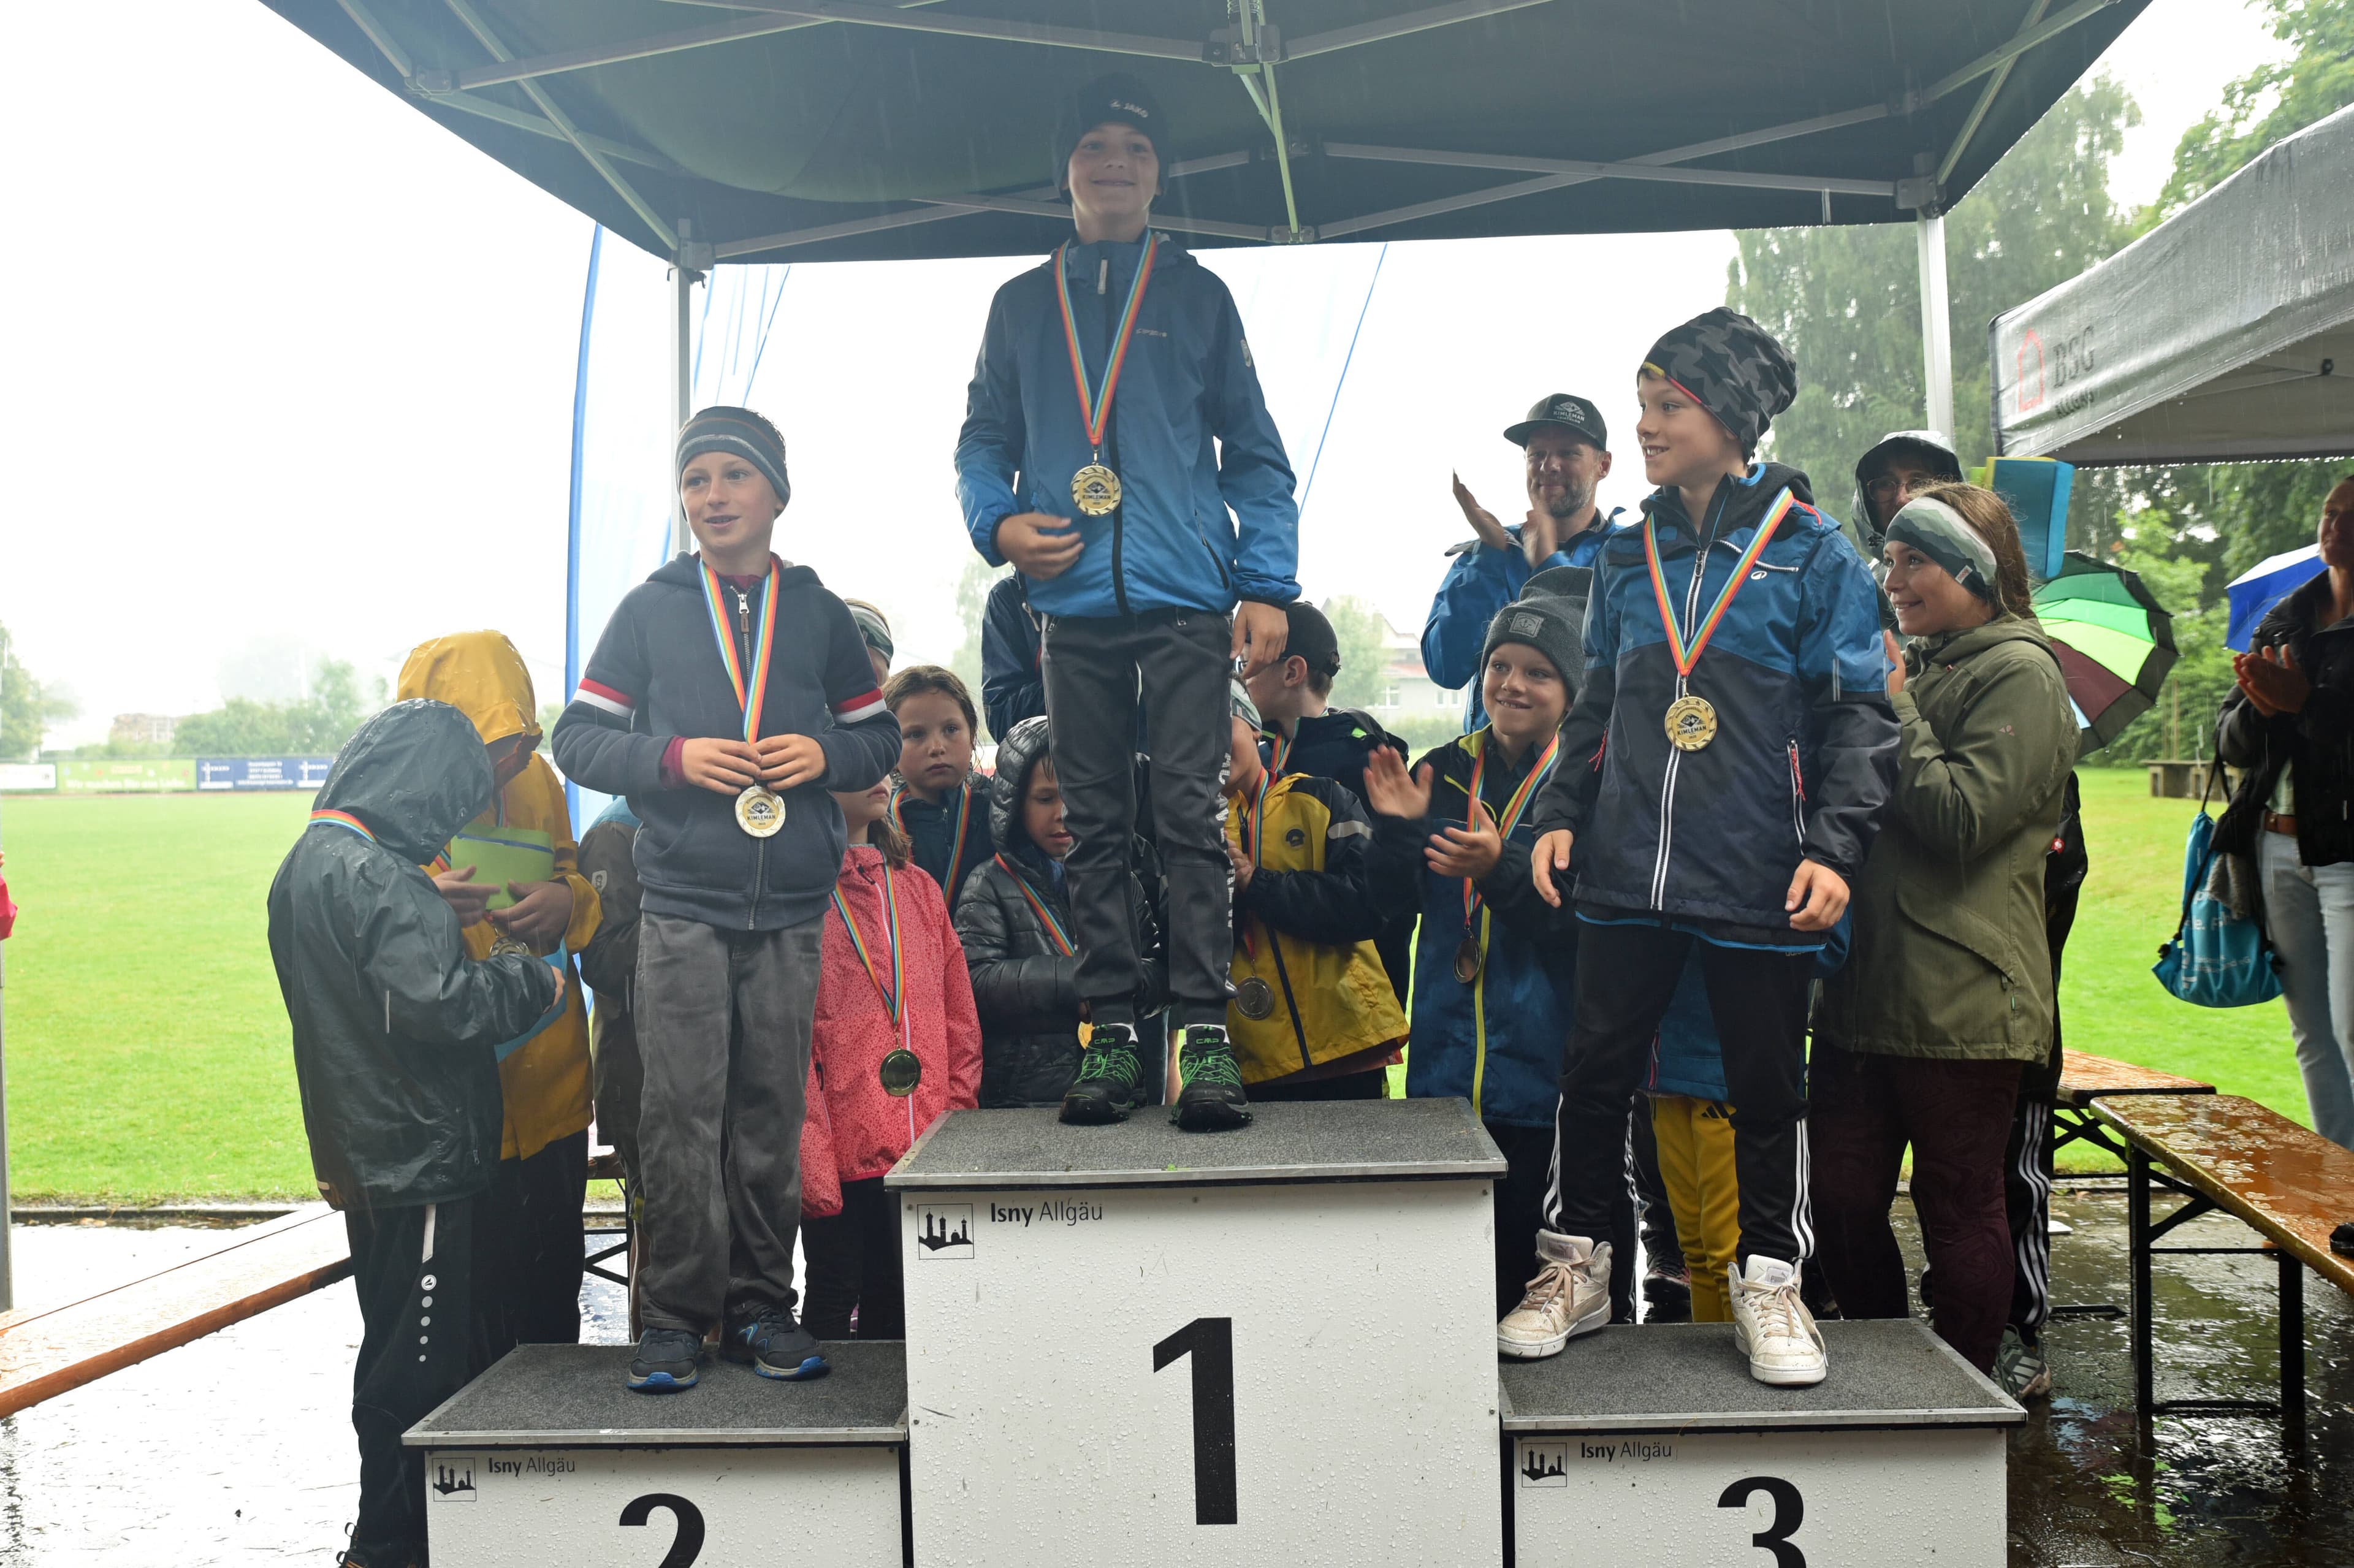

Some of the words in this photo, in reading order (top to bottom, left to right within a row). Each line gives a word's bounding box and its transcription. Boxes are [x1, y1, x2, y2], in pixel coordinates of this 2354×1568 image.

[2053, 325, 2095, 389] BSG
[1553, 411, 1585, 422] KIMLEMAN
[1677, 725, 1707, 736] KIMLEMAN
[990, 1203, 1033, 1227] Isny
[1038, 1199, 1103, 1226] Allgäu
[1153, 1317, 1238, 1525] 1
[1581, 1442, 1616, 1461] Isny
[1620, 1441, 1672, 1461] Allgäu
[488, 1458, 522, 1478] Isny
[525, 1456, 576, 1476] Allgäu
[619, 1493, 705, 1568] 2
[1717, 1476, 1807, 1568] 3
